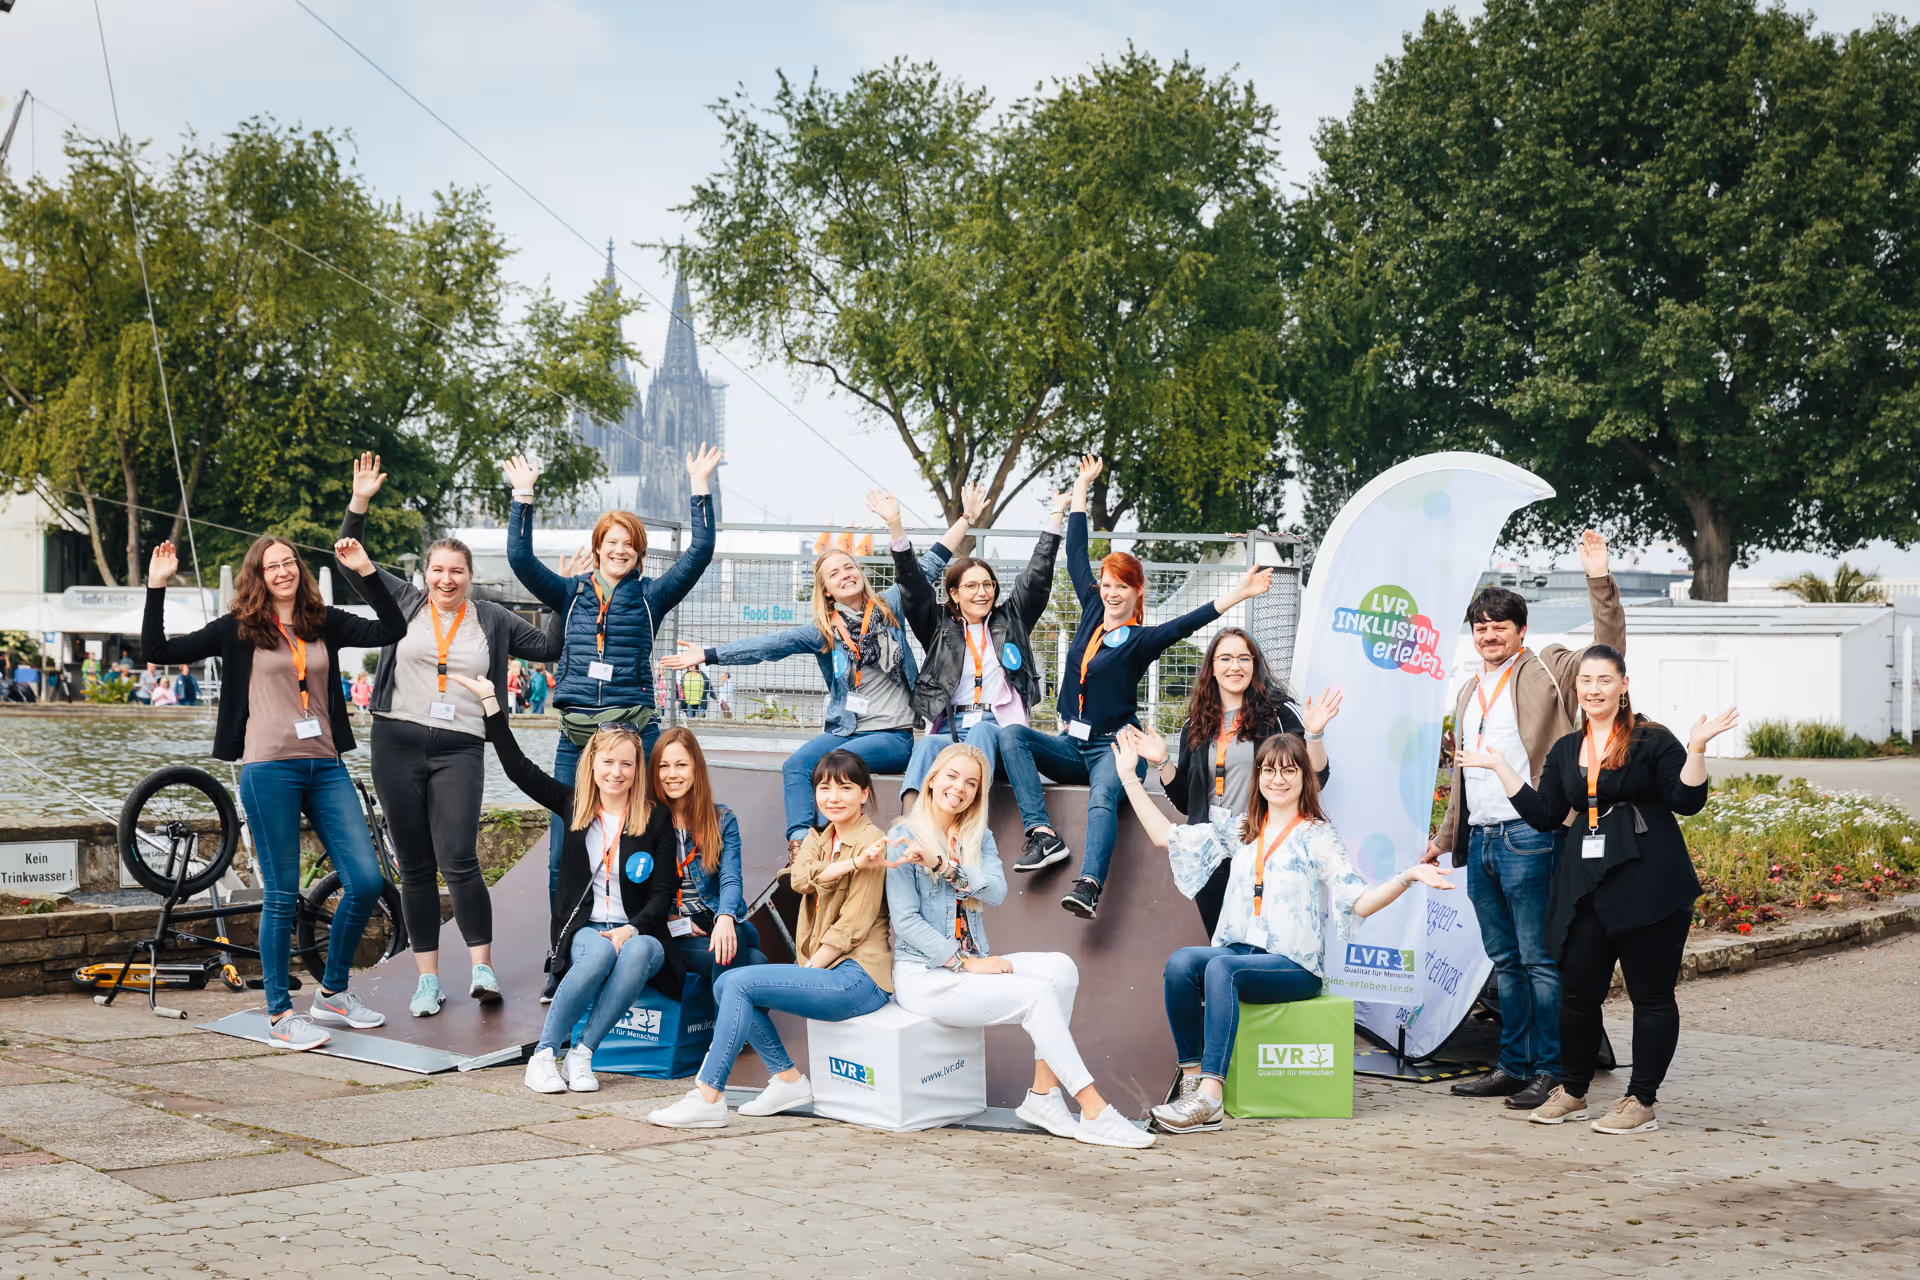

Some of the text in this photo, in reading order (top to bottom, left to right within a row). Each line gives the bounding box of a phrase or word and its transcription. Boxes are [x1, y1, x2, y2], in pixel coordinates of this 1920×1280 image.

[773, 605, 793, 620] Box
[1371, 593, 1412, 618] LVR.
[1336, 611, 1436, 650] INKLUSION
[1372, 640, 1443, 677] erleben.
[25, 852, 48, 865] Kein
[1, 872, 66, 884] Trinkwasser
[1349, 946, 1390, 967] LVR
[1343, 966, 1371, 976] Qualität
[1384, 971, 1415, 980] Menschen
[616, 1028, 626, 1036] für
[627, 1030, 659, 1042] Menschen
[1262, 1047, 1304, 1065] LVR
[831, 1058, 858, 1079] LVR
[920, 1059, 965, 1085] www.lvr.de
[1257, 1068, 1334, 1077] Qualität für Menschen
